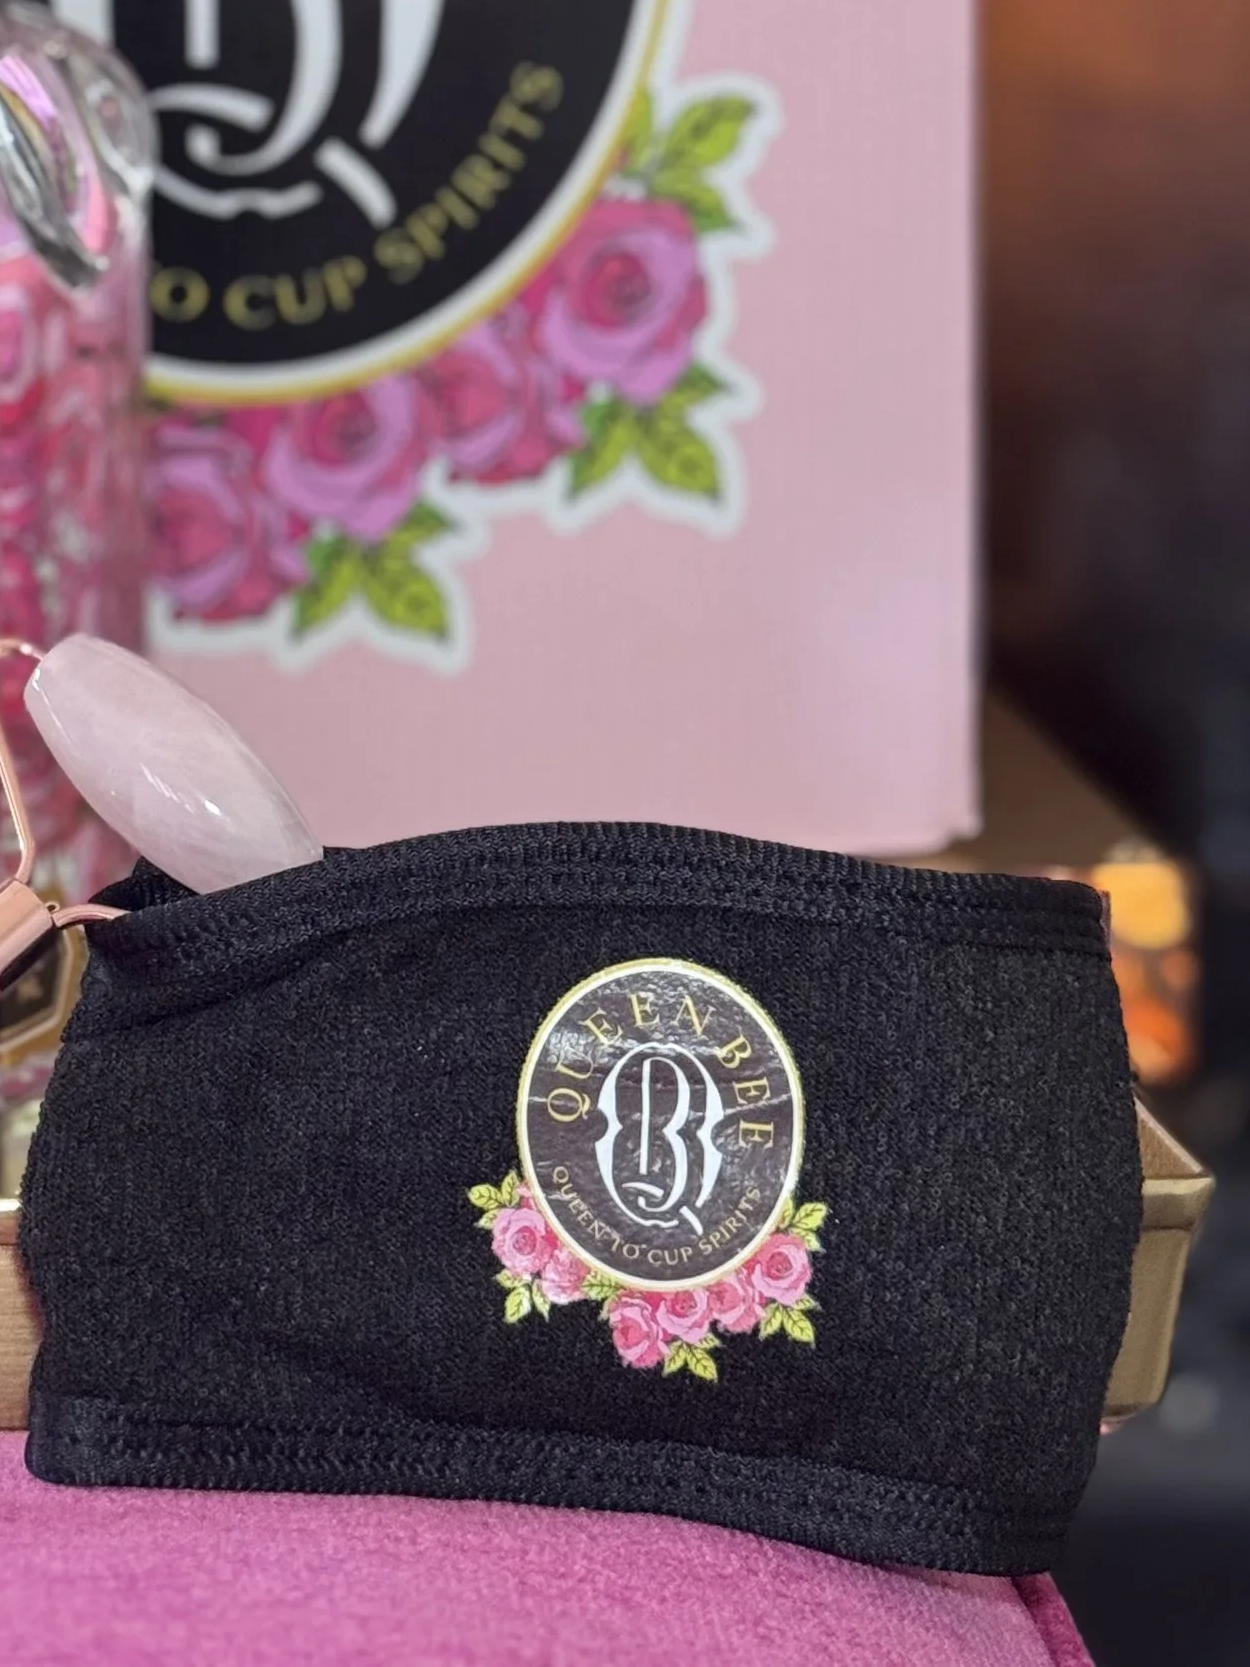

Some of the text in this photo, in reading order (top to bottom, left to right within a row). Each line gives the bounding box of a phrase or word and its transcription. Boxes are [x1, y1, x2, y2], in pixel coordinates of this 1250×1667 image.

[151, 60, 564, 331] O CUP SPIRITS
[547, 990, 774, 1149] QUEEN BEE
[553, 1165, 762, 1266] QUEEN TO CUP SPIRITS
